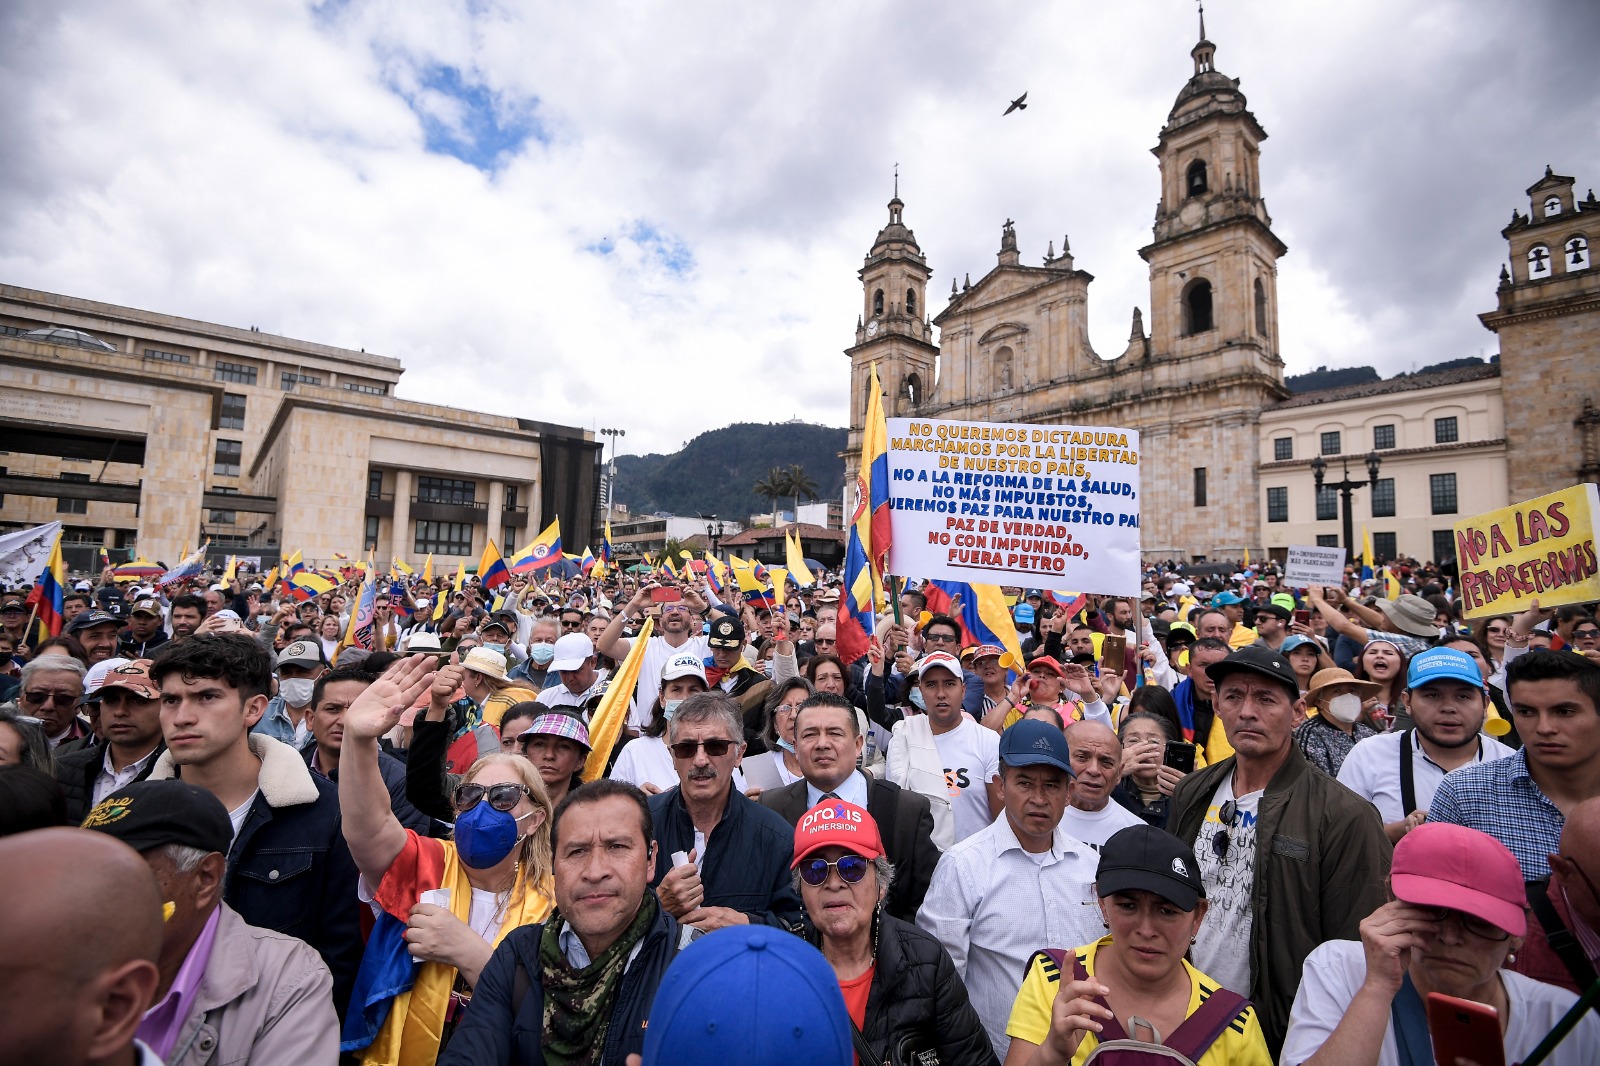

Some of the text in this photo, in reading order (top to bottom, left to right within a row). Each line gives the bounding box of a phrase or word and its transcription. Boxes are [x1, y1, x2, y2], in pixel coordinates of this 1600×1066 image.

[910, 423, 1128, 447] NO QUEREMOS DICTADURA
[891, 438, 1138, 465] MARCHAMOS POR LA LIBERTAD
[939, 455, 1091, 479] DE NUESTRO PAÍS,
[894, 468, 1135, 500] NO A LA REFORMA DE LA SALUD,
[889, 497, 957, 514] UEREMOS
[961, 503, 989, 516] PAZ
[994, 505, 1034, 519] PARA
[1038, 508, 1114, 525] NUESTRO
[932, 485, 1092, 511] NO MÁS IMPUESTOS,
[946, 517, 1072, 542] PAZ DE VERDAD,
[1457, 502, 1570, 570] NO A LAS
[928, 532, 1089, 560] NO CON IMPUNIDAD,
[948, 548, 1065, 571] FUERA PETRO
[1461, 540, 1598, 610] PETROREFORMAS
[674, 660, 702, 671] CABAL
[802, 803, 862, 832] praxis
[809, 822, 857, 834] INMERSION
